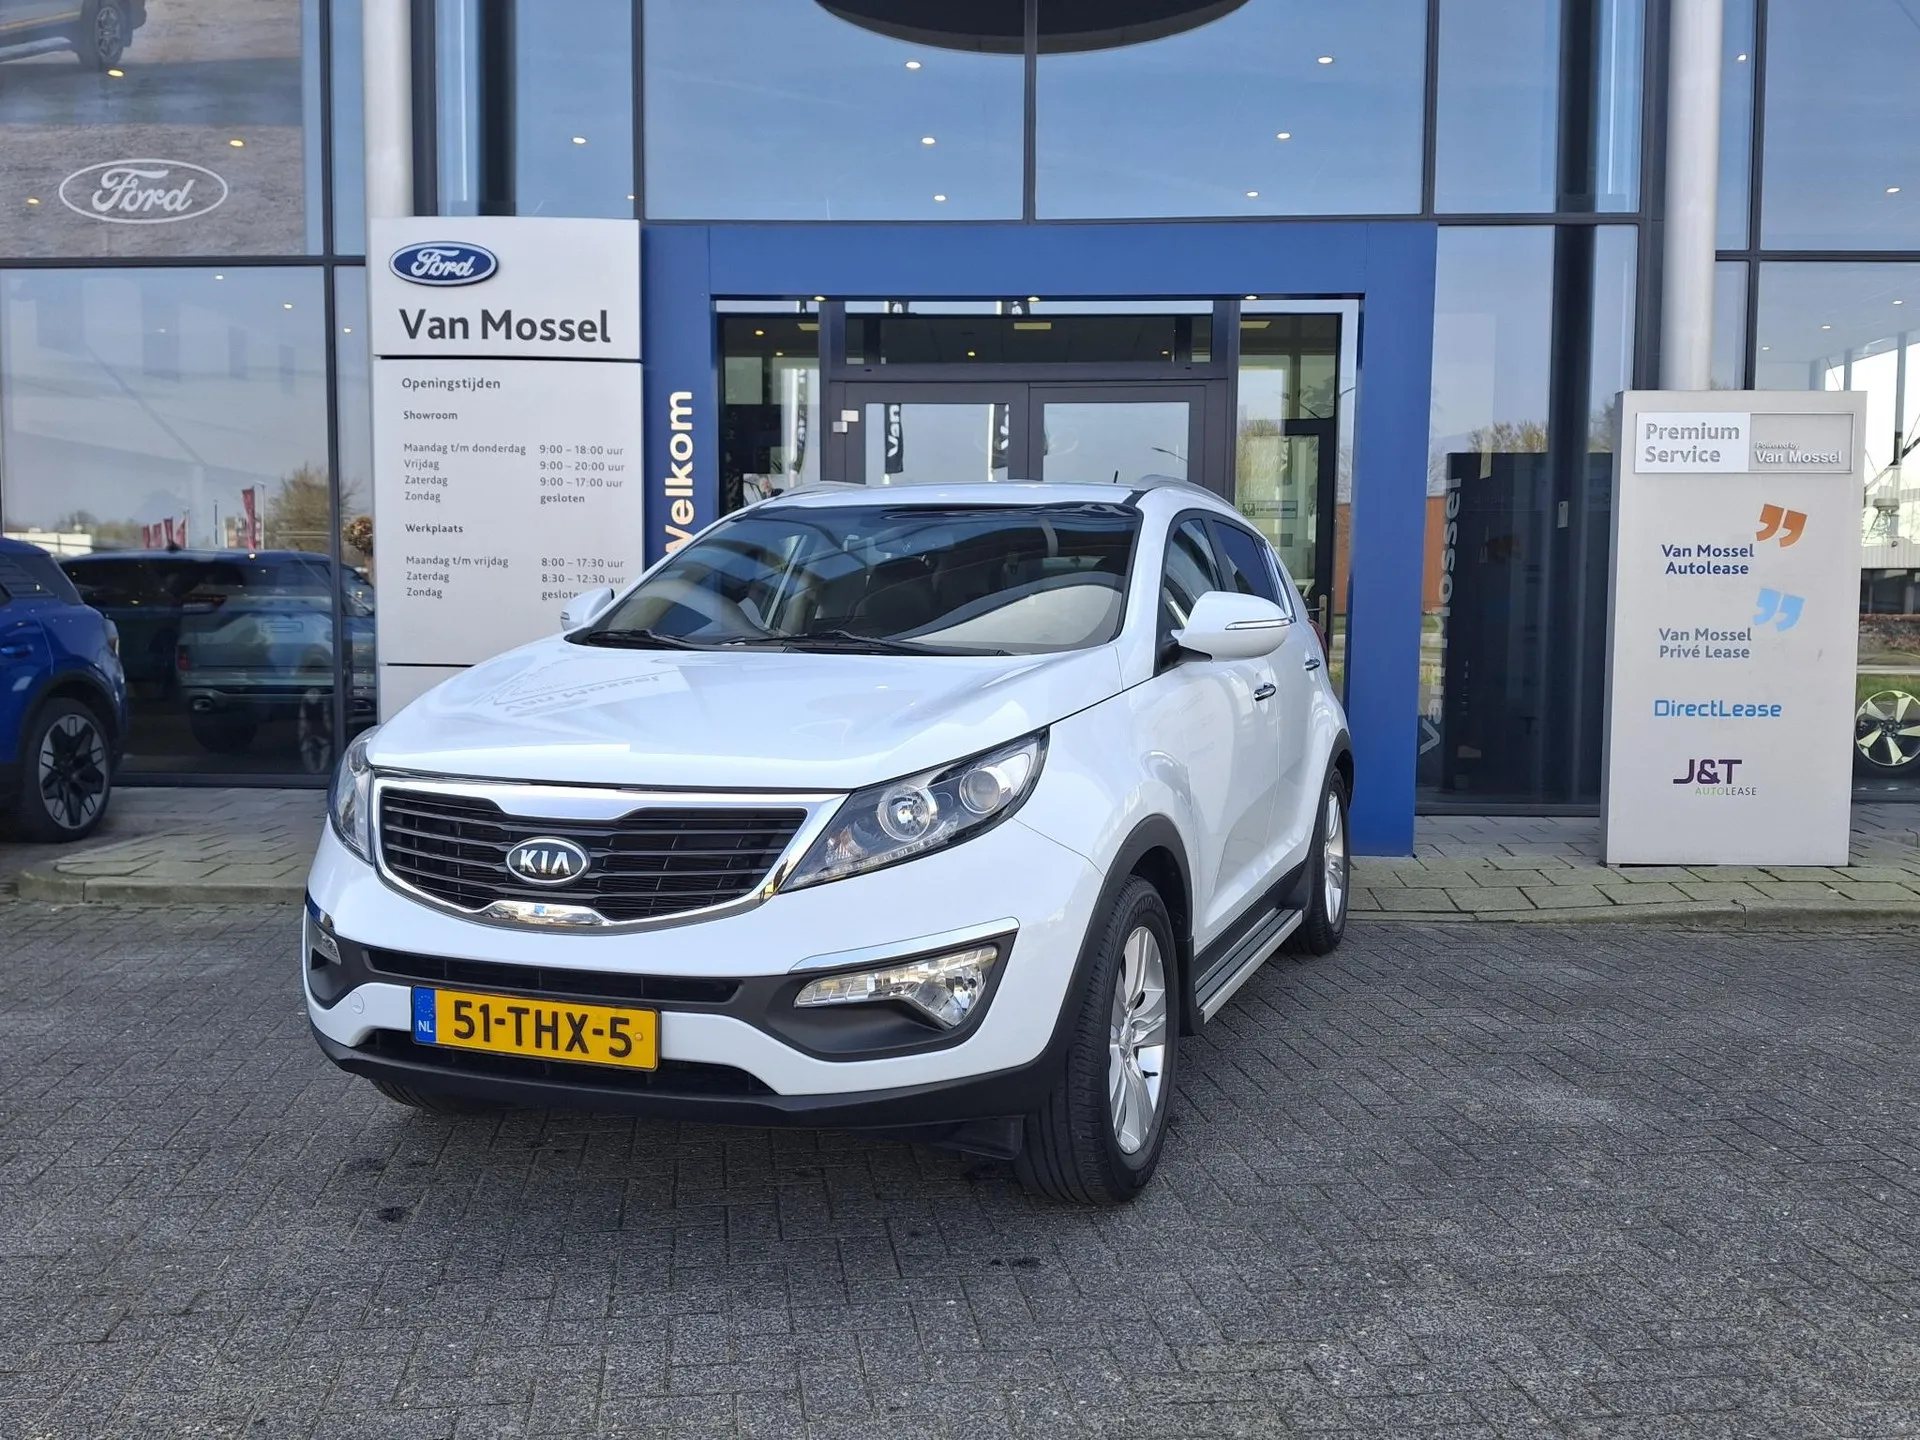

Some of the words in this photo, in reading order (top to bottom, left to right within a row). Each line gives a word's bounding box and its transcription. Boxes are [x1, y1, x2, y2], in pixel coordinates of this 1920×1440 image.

[92, 168, 195, 211] Ford
[411, 249, 475, 277] Ford
[399, 309, 469, 339] Van
[481, 309, 611, 342] Mossel
[402, 378, 500, 391] Openingstijden
[404, 411, 457, 420] Showroom
[1645, 422, 1739, 440] Premium
[404, 443, 447, 454] Maandag
[451, 443, 469, 452] t/m
[472, 444, 526, 455] donderdag
[540, 445, 562, 453] 9:00
[575, 445, 603, 455] 18:00
[1645, 446, 1721, 462] Service
[1755, 451, 1785, 463] Van
[1788, 451, 1842, 463] Mossel
[404, 459, 439, 470] Vrijdag
[540, 461, 563, 470] 9:00
[575, 462, 604, 471] 20:00
[405, 475, 448, 487] Zaterdag
[540, 477, 563, 486] 9:00
[576, 478, 603, 487] 17:00
[405, 491, 440, 503] Zondag
[541, 494, 584, 504] gesloten
[406, 524, 463, 535] Werkplaats
[1661, 545, 1692, 557] Van
[1697, 545, 1754, 557] Mossel
[407, 556, 449, 567] Maandag
[453, 557, 471, 565] t/m
[474, 557, 508, 568] vrijdag
[542, 558, 564, 566] 8:00
[577, 559, 604, 567] 17:30
[1665, 562, 1749, 575] Autolease
[407, 572, 449, 583] Zaterdag
[542, 574, 564, 582] 8:30
[577, 575, 605, 583] 12:30
[609, 576, 624, 584] uur
[407, 588, 442, 599] Zondag
[541, 591, 580, 600] geslote
[1659, 628, 1690, 641] Van
[1695, 628, 1751, 641] Mossel
[1660, 645, 1700, 658] Privé
[1705, 645, 1750, 658] Lease
[1654, 700, 1782, 716] DirectLease
[1673, 759, 1742, 784] J&T
[1695, 787, 1757, 795] AUTOLEASE
[519, 849, 571, 875] KIA
[418, 1019, 433, 1032] NL
[454, 1000, 632, 1057] 51-THX-5
